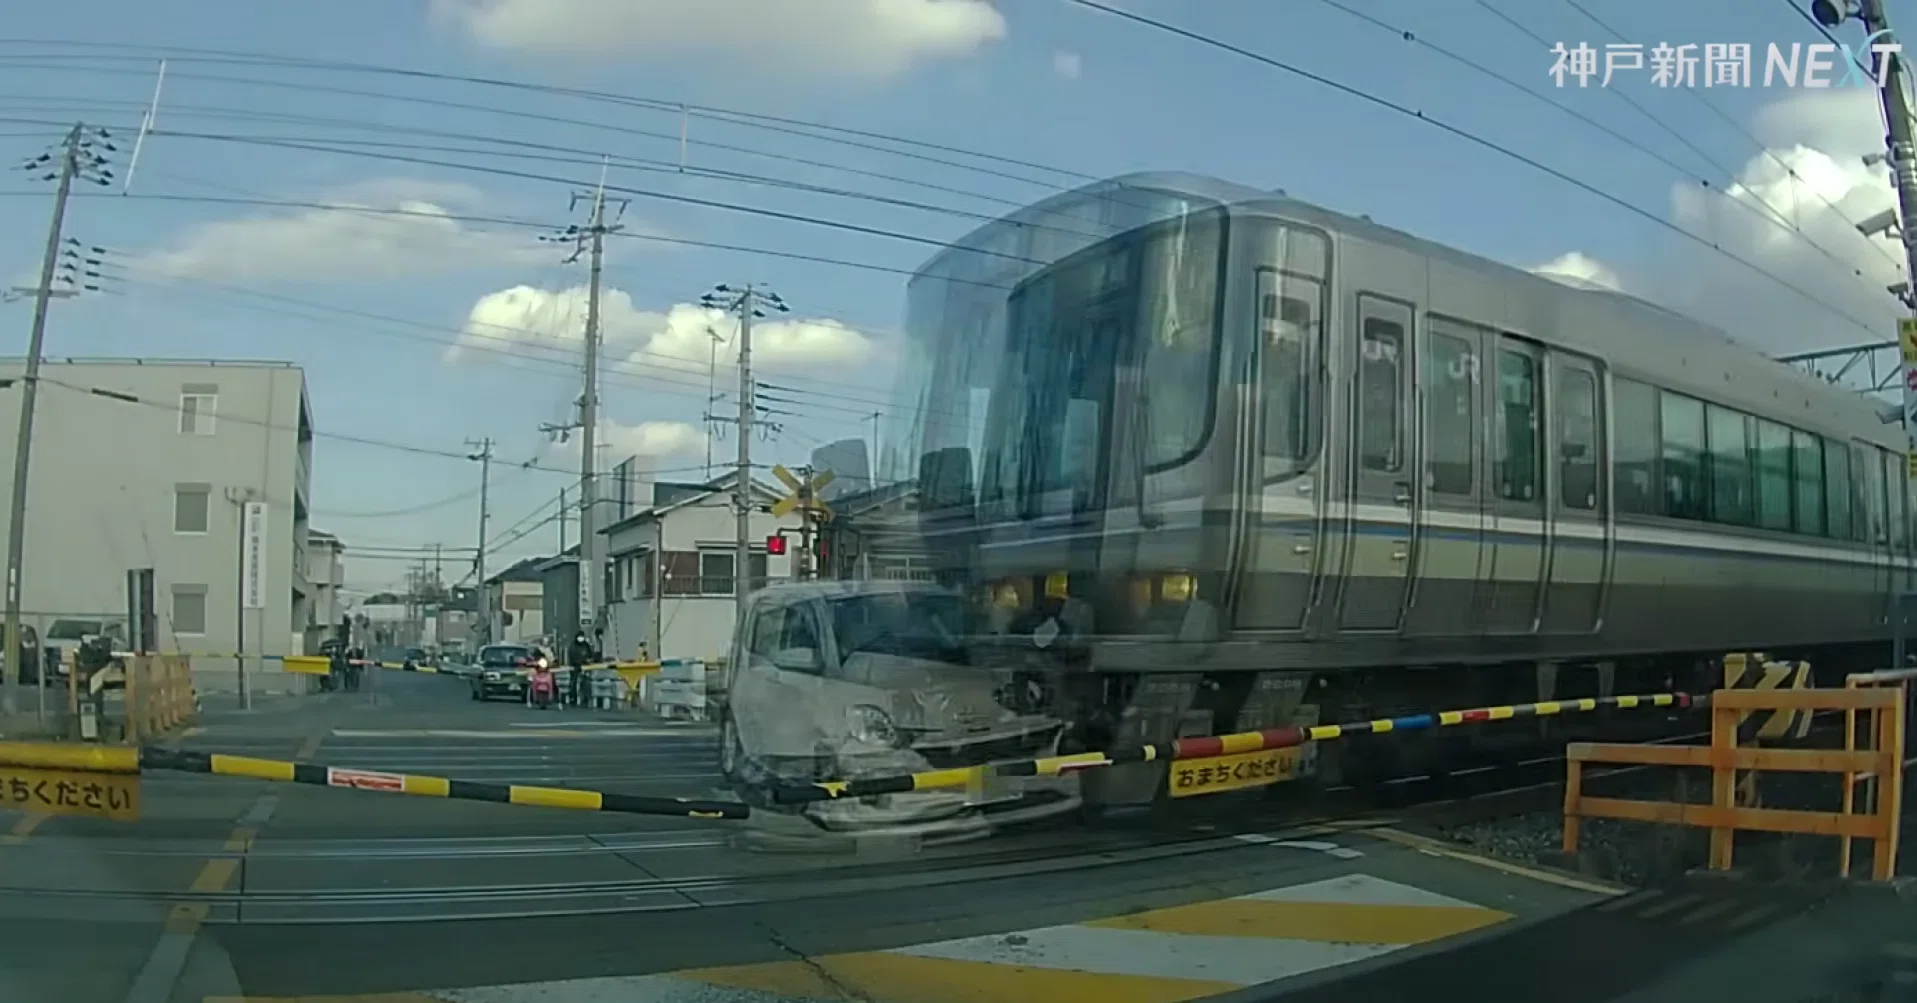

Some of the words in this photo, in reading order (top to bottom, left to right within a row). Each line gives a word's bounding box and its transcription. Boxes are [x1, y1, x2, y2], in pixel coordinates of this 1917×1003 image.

[1448, 351, 1480, 384] JR
[0, 777, 131, 810] ちください
